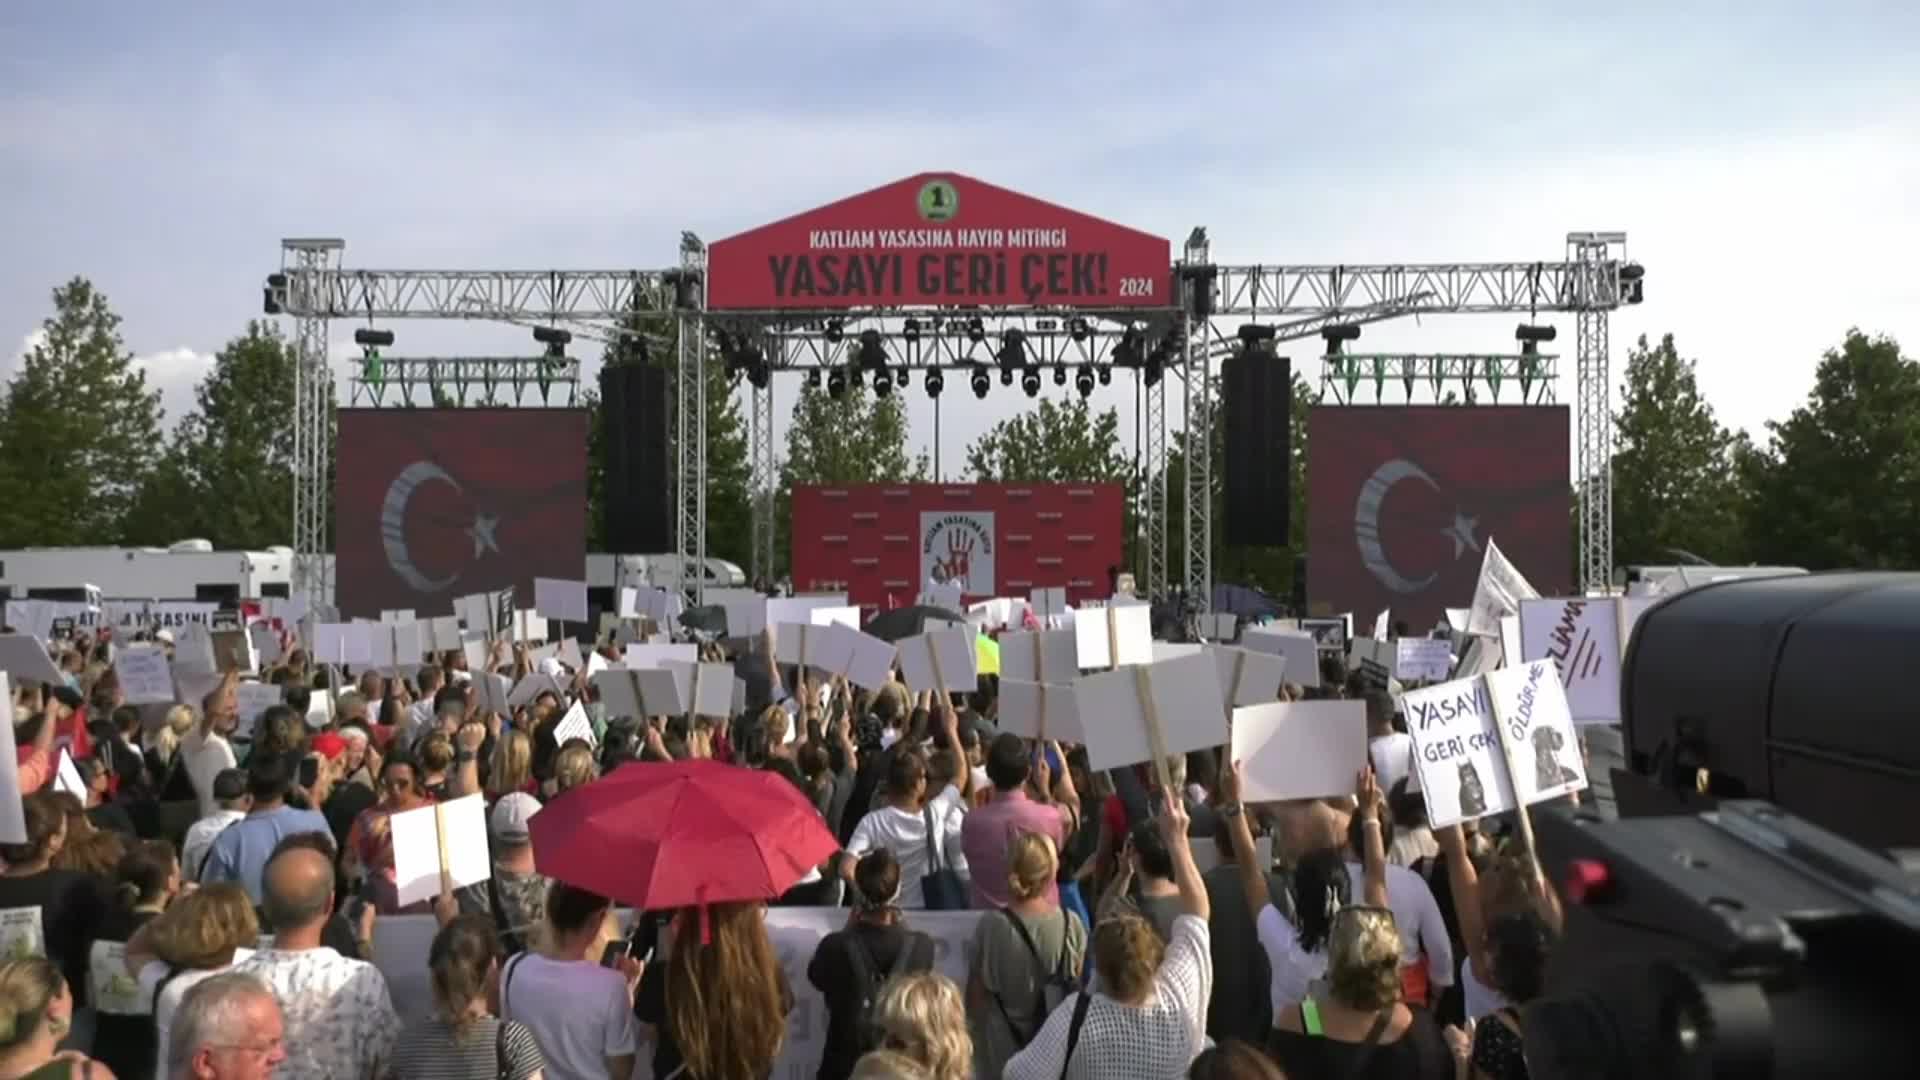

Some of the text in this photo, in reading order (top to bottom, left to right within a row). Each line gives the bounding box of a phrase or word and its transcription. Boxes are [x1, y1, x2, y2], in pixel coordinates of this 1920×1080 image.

[878, 229, 954, 249] YASASINA
[958, 228, 1003, 249] HAYIR
[1007, 227, 1067, 248] MİTİNGİ
[769, 250, 1107, 302] YASAYI GERİ ÇEK!
[1119, 278, 1153, 297] 2024
[1411, 687, 1486, 731] YASAYI
[1424, 735, 1466, 763] GERİ
